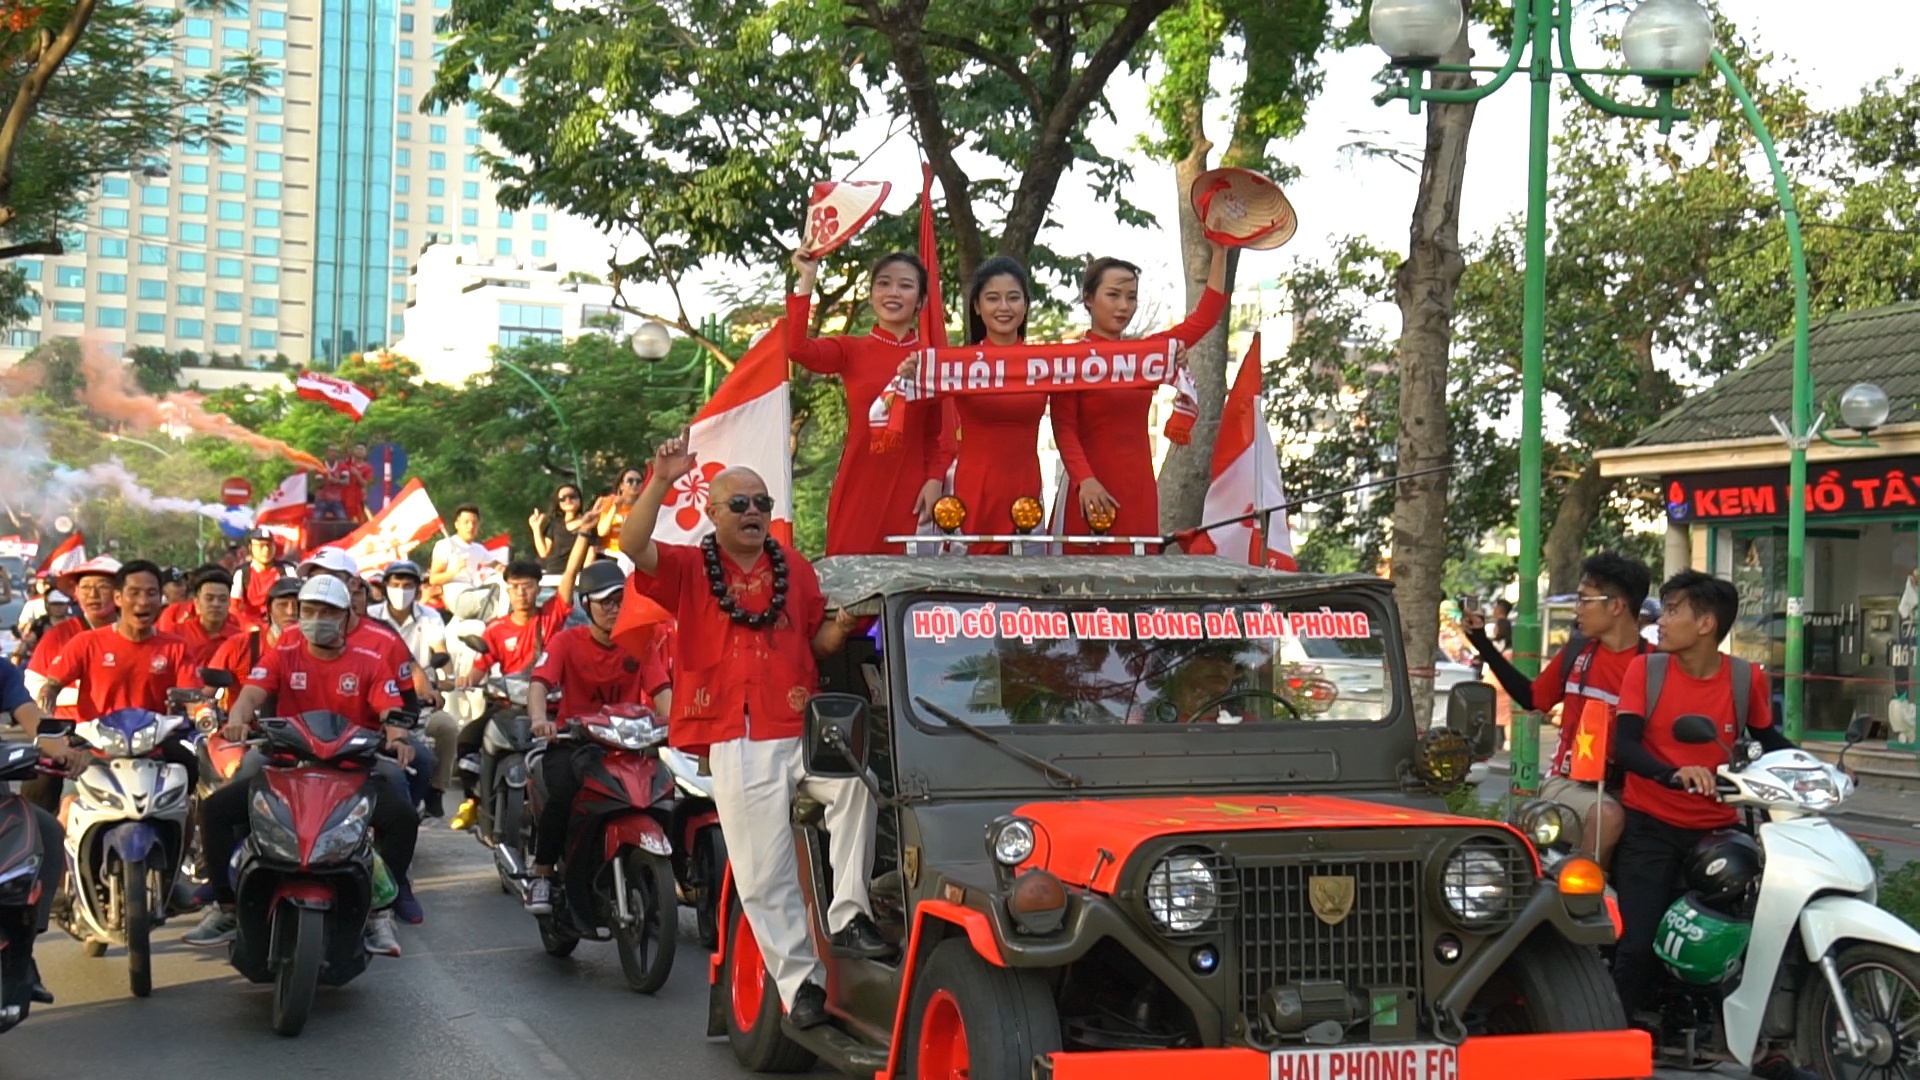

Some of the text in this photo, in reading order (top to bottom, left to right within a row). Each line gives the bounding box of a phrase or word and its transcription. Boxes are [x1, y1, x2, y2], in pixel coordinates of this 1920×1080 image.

[940, 348, 1167, 392] HẢI PHÒNG
[1694, 485, 1776, 517] KEM
[1852, 470, 1920, 510] TÂ
[912, 601, 1371, 644] HỘI CỔ ĐỘNG VIÊN BÓNG ĐÁ HẢI PHÒNG
[1277, 1053, 1320, 1080] HAI
[1329, 1049, 1417, 1080] PHONG
